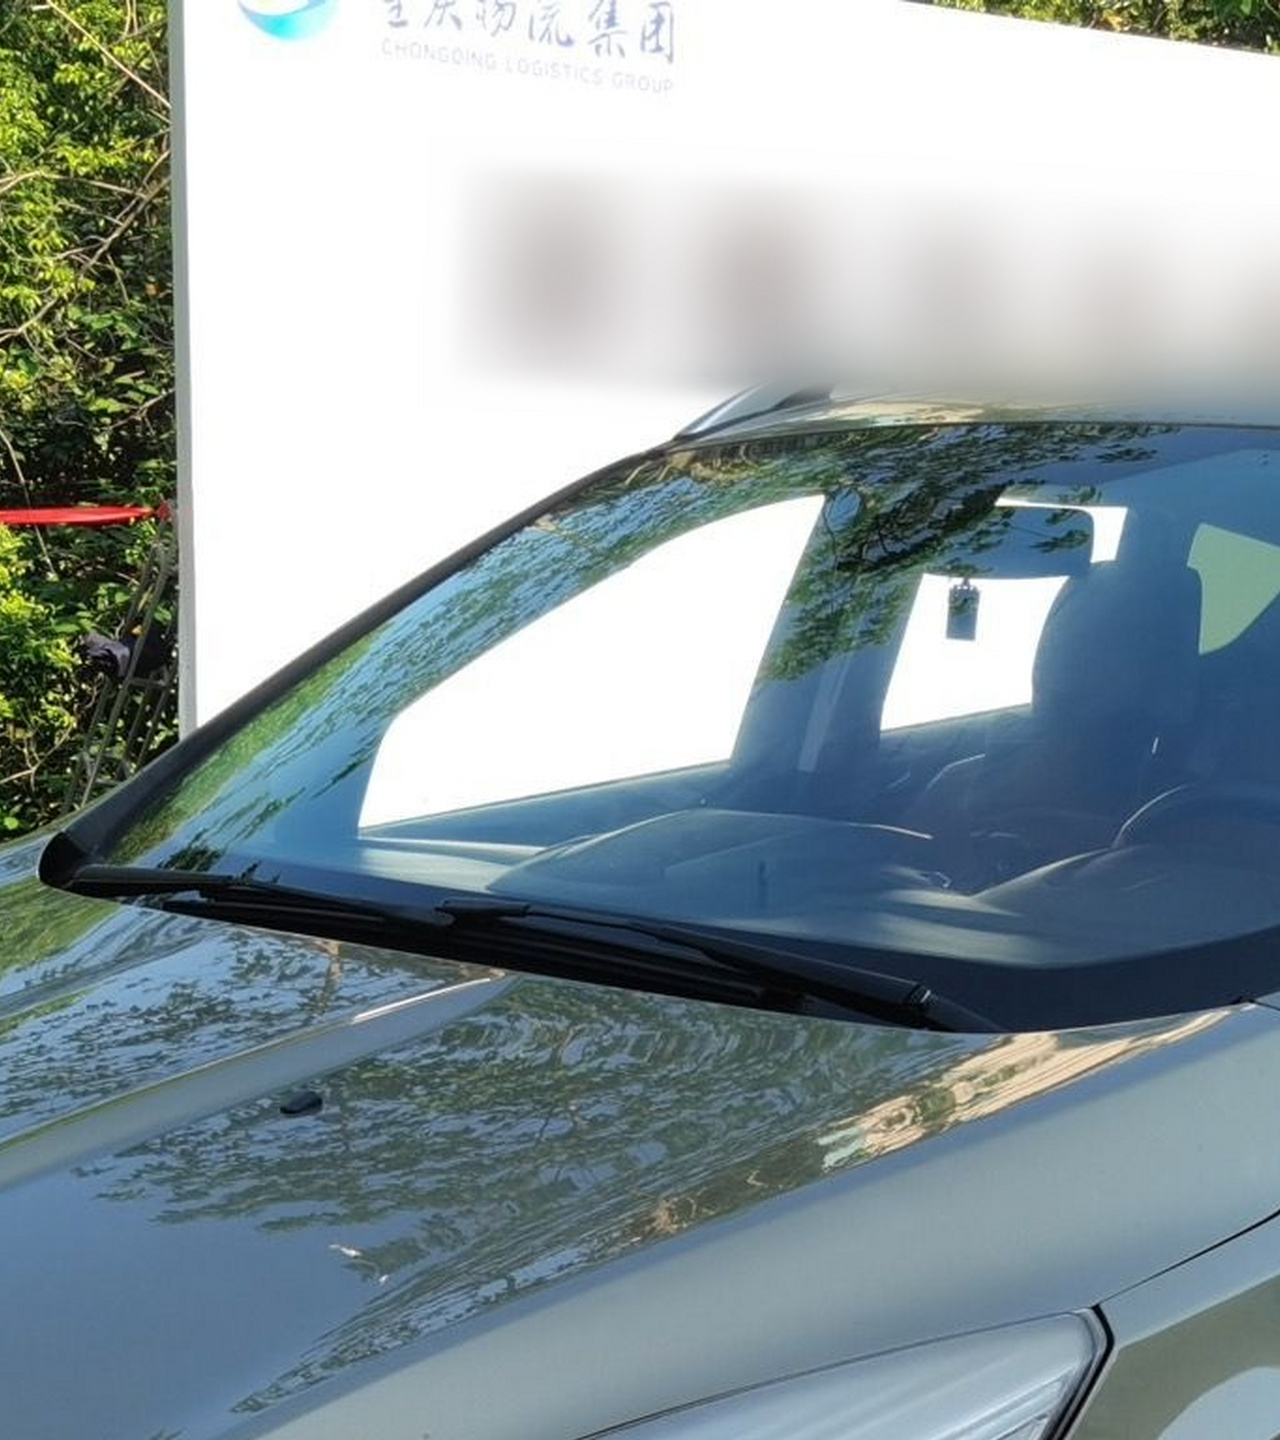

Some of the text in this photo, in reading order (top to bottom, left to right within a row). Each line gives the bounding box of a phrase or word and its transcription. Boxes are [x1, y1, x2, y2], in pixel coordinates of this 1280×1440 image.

[381, 37, 675, 95] CHONGQING LOGISTICS GROUP
